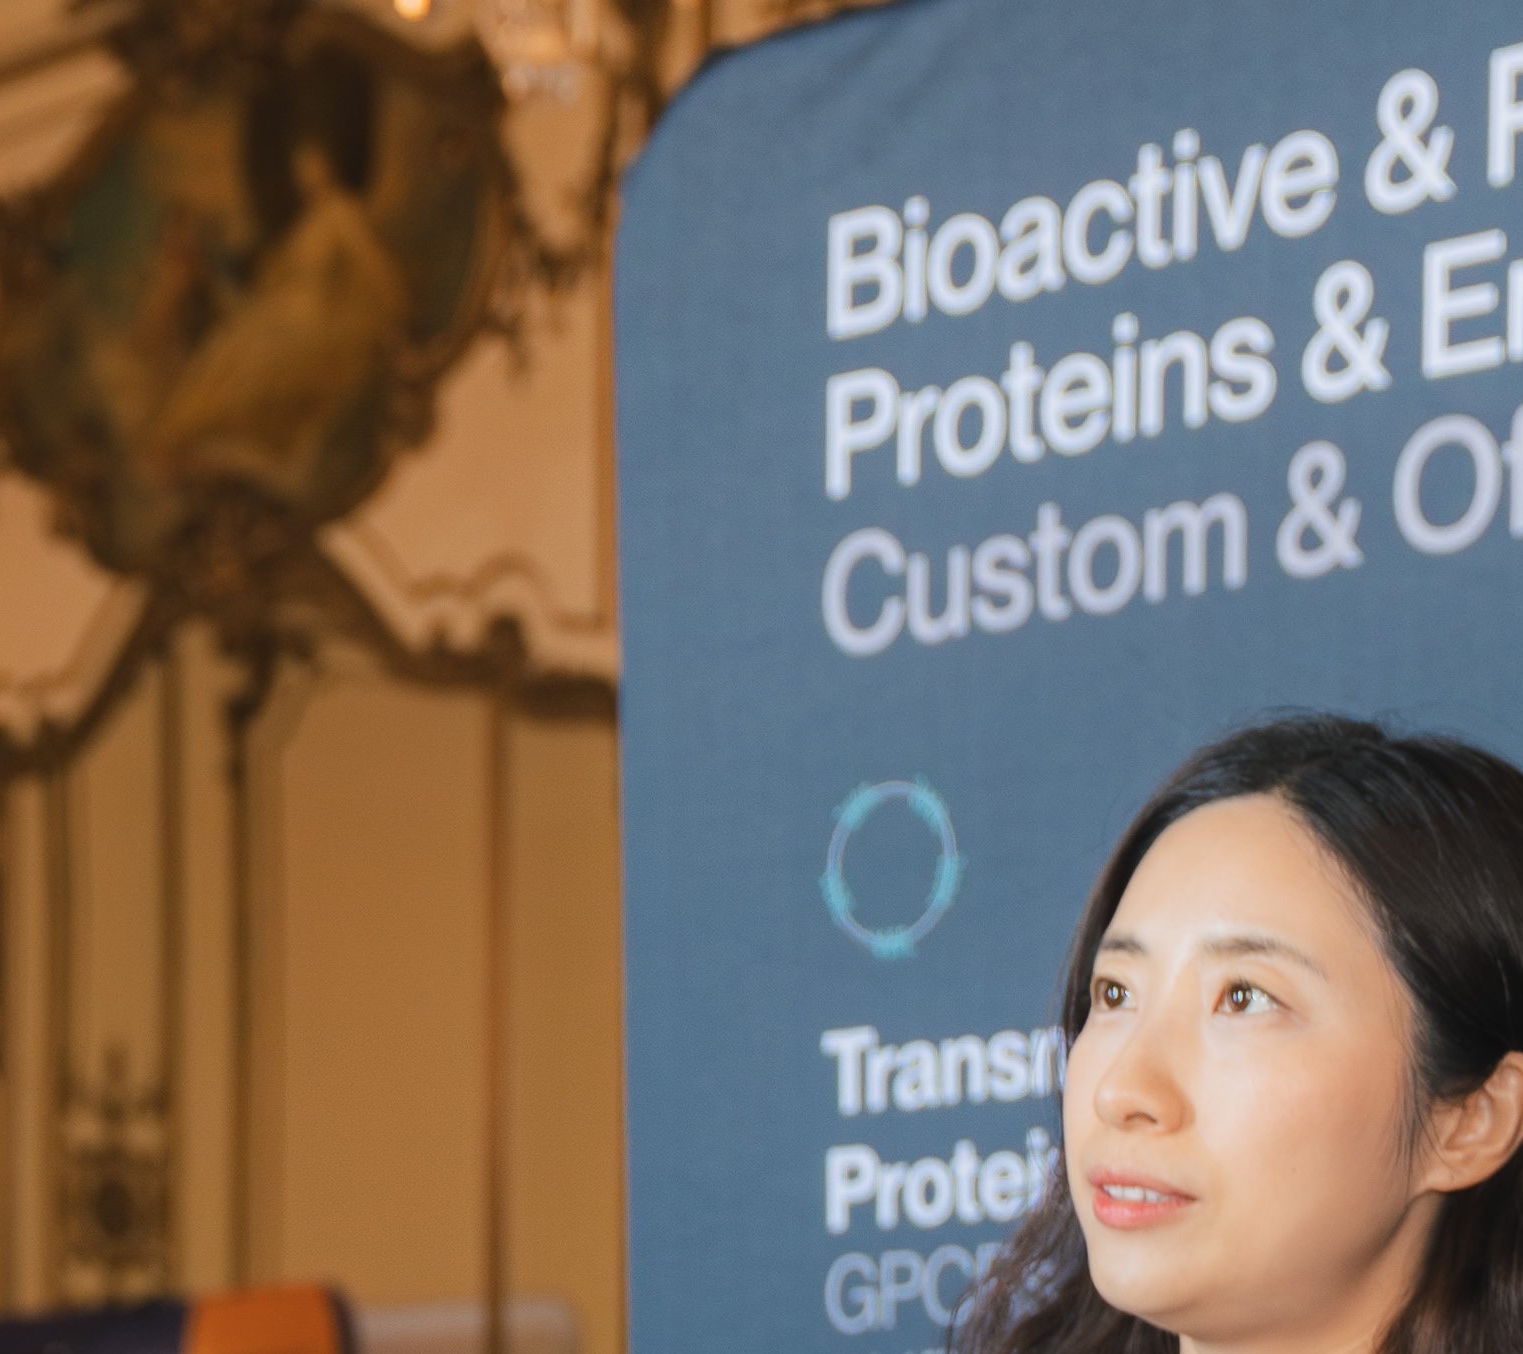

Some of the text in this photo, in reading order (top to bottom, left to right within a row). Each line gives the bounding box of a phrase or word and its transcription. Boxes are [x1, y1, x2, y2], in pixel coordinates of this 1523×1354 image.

[826, 128, 1339, 341] Bioactive
[1364, 67, 1457, 216] &
[824, 312, 1277, 500] Proteins
[1301, 259, 1392, 404] &
[820, 493, 1250, 658] Custom
[1275, 439, 1364, 581] &
[824, 1126, 1062, 1235] Protei
